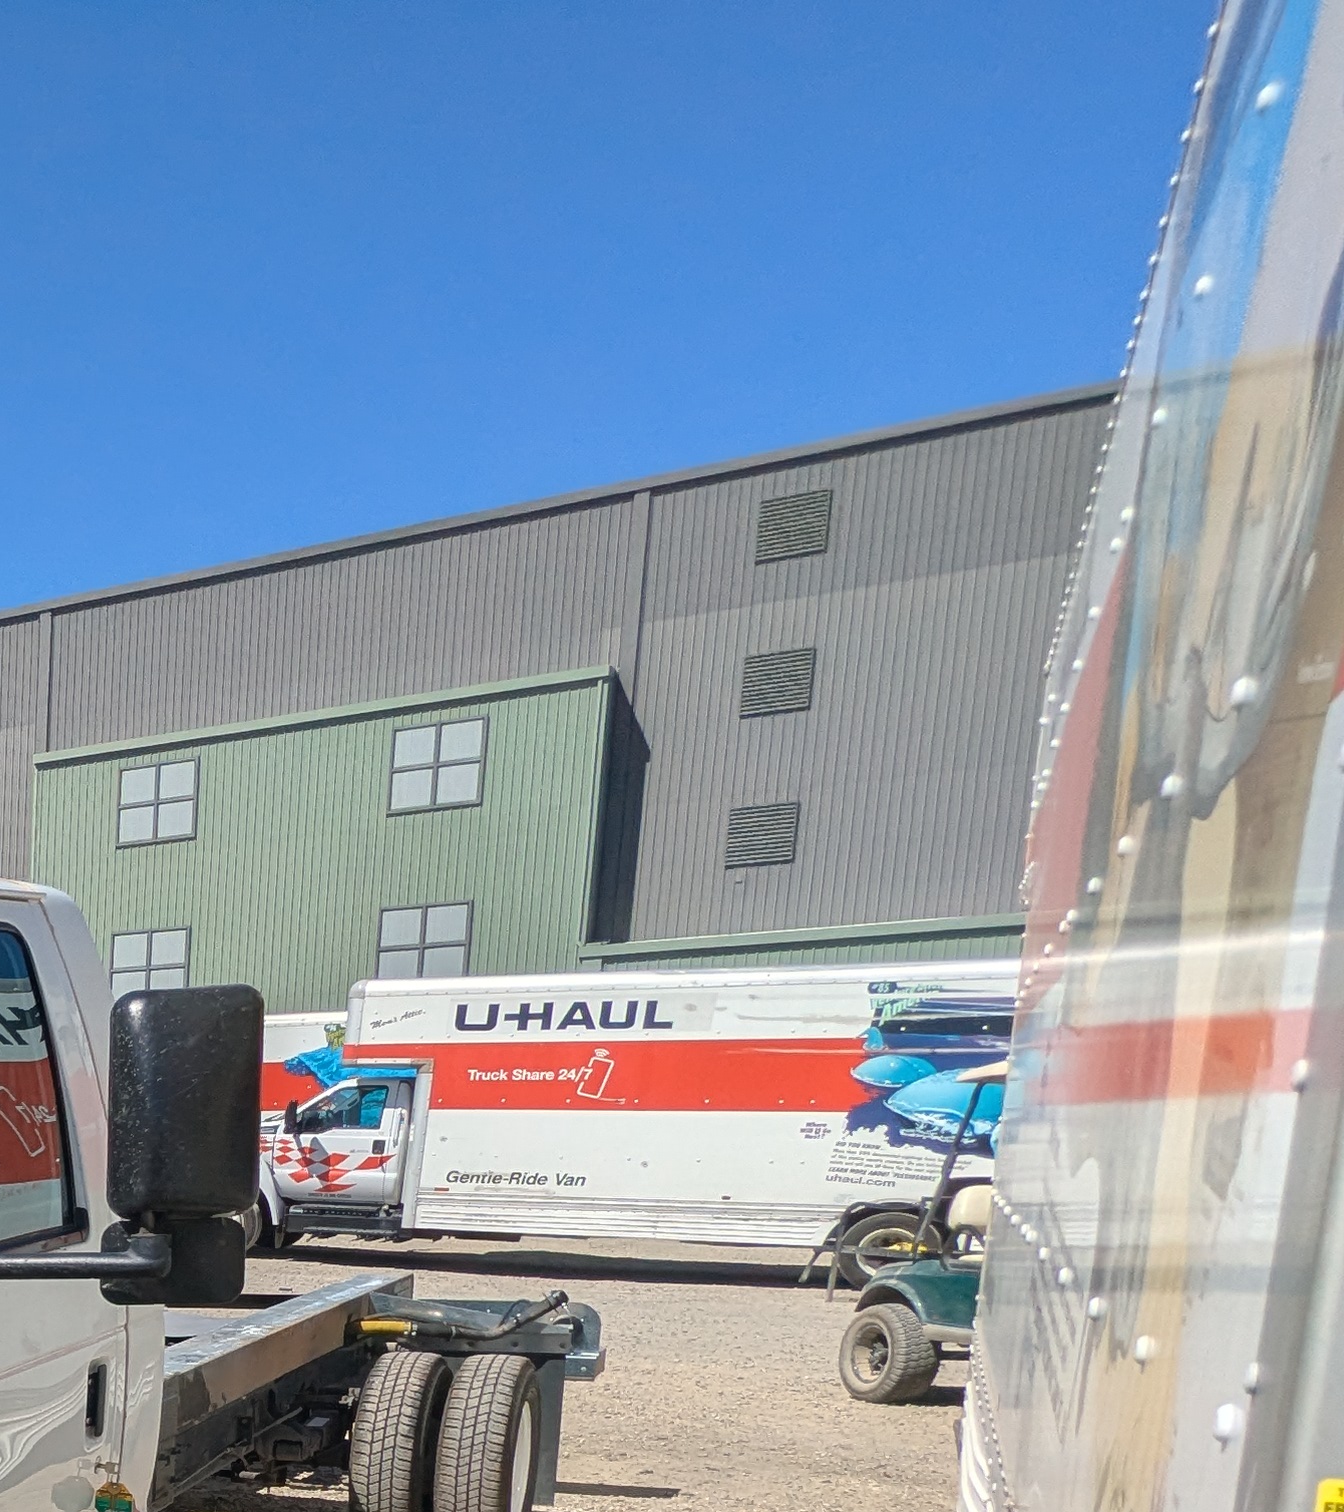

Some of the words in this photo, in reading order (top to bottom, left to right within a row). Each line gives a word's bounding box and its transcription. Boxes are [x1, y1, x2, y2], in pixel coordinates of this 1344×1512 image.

[454, 1000, 674, 1032] U-HAUL
[467, 1069, 508, 1082] Truck
[512, 1068, 555, 1082] Share
[558, 1066, 593, 1083] 24/7
[555, 1172, 588, 1187] Van
[825, 1173, 897, 1188] uhaul.com
